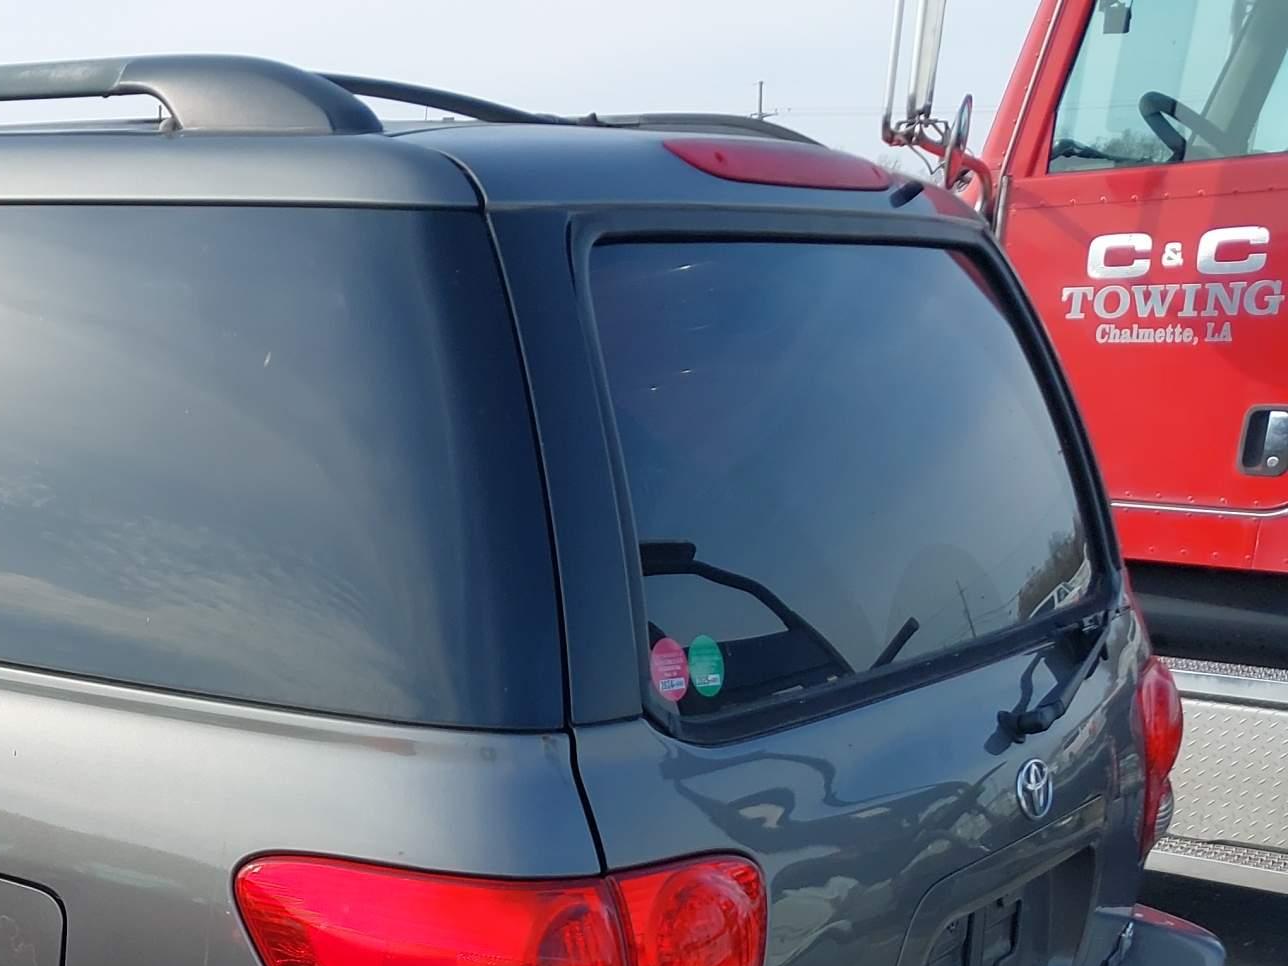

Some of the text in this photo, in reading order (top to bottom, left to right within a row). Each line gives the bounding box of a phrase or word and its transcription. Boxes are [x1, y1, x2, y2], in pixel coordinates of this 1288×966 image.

[1087, 226, 1271, 280] C & C
[1062, 279, 1286, 320] TOWING
[1095, 322, 1233, 345] Chalmette, LA
